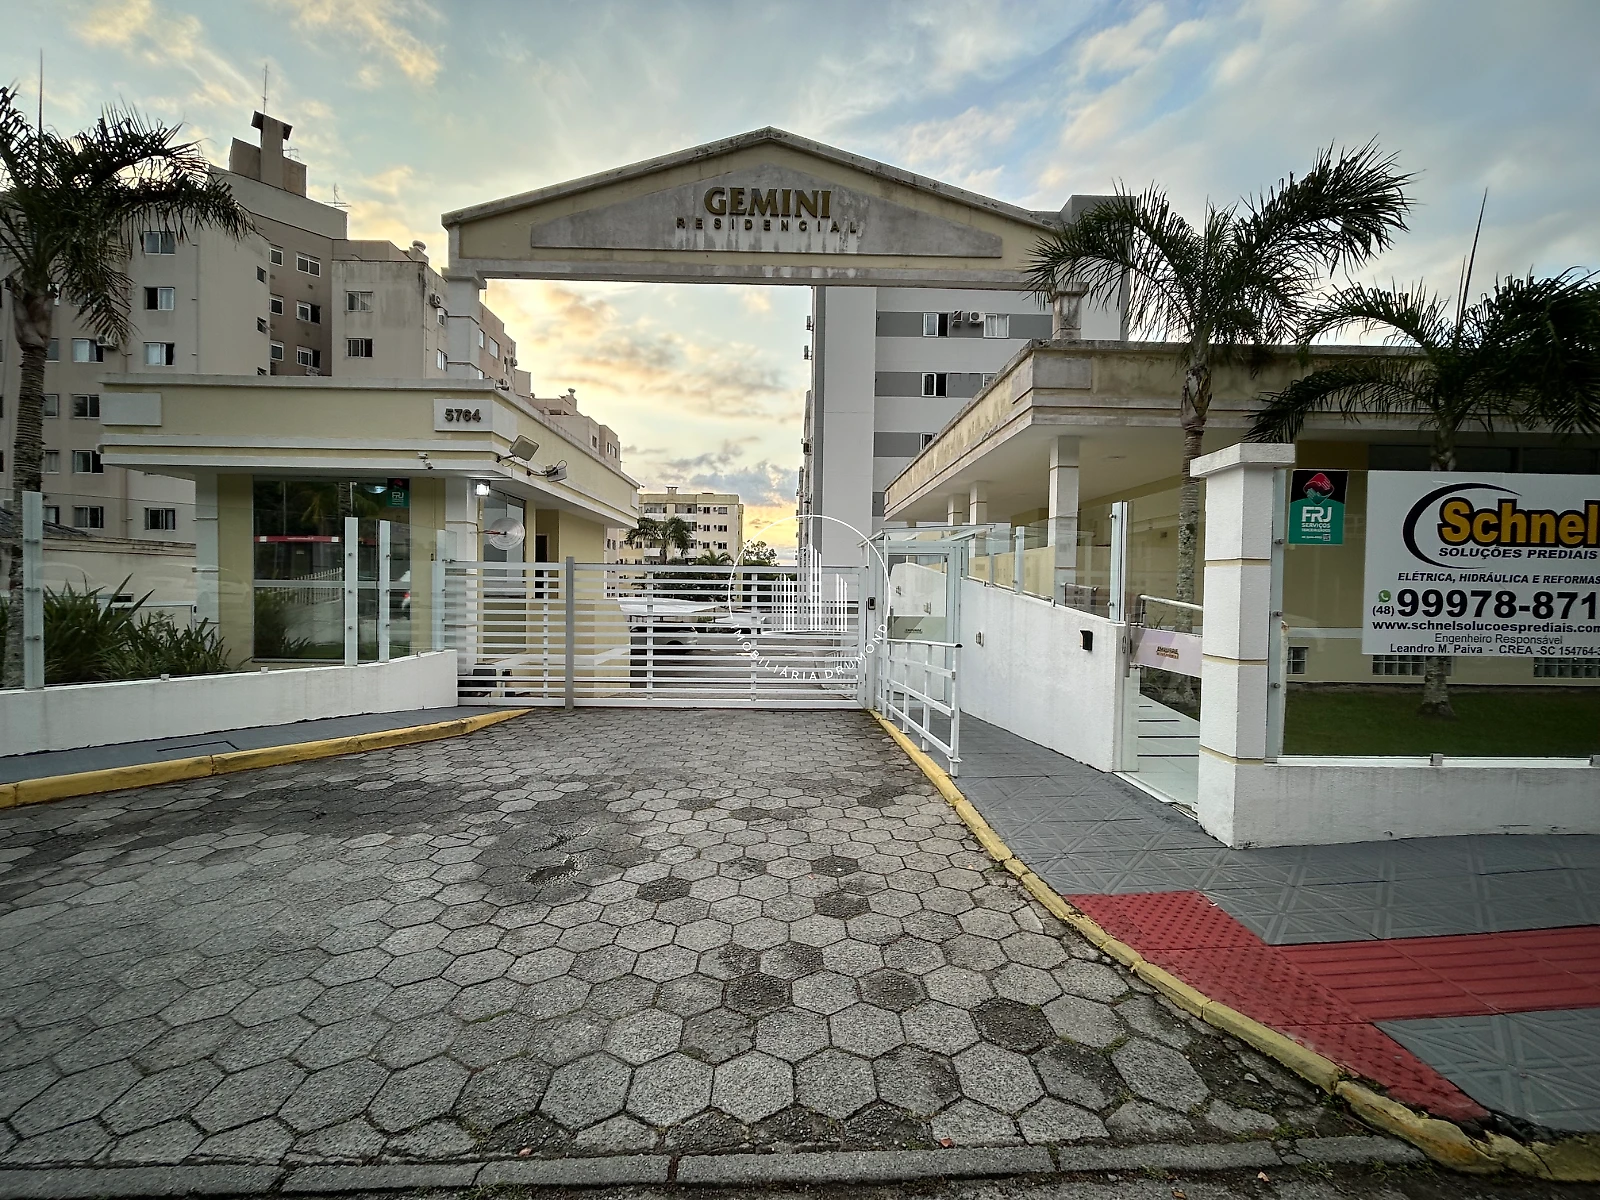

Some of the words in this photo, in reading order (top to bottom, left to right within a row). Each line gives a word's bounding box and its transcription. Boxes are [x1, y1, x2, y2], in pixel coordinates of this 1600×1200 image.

[704, 187, 832, 218] GEMINI
[676, 217, 857, 233] RESIDENCIAL
[445, 408, 482, 423] 5764
[391, 491, 405, 499] FRJ
[1301, 506, 1332, 522] FRJ
[1438, 497, 1600, 547] Schnel
[1438, 547, 1522, 560] SOLUÇÕES
[1527, 549, 1598, 560] PREDIAIS
[1398, 571, 1456, 584] ELÉTRICA,
[1459, 572, 1529, 584] HIDRÁULICA
[1532, 574, 1540, 584] E
[1543, 575, 1600, 585] REFORMAS
[1372, 605, 1395, 617] (48)
[1434, 633, 1492, 645] Engenheiro
[1495, 634, 1563, 646] Responsável
[1390, 643, 1435, 653] Leandro
[1438, 644, 1450, 653] M.
[1453, 644, 1483, 654] Paiva
[1498, 645, 1533, 654] CREA
